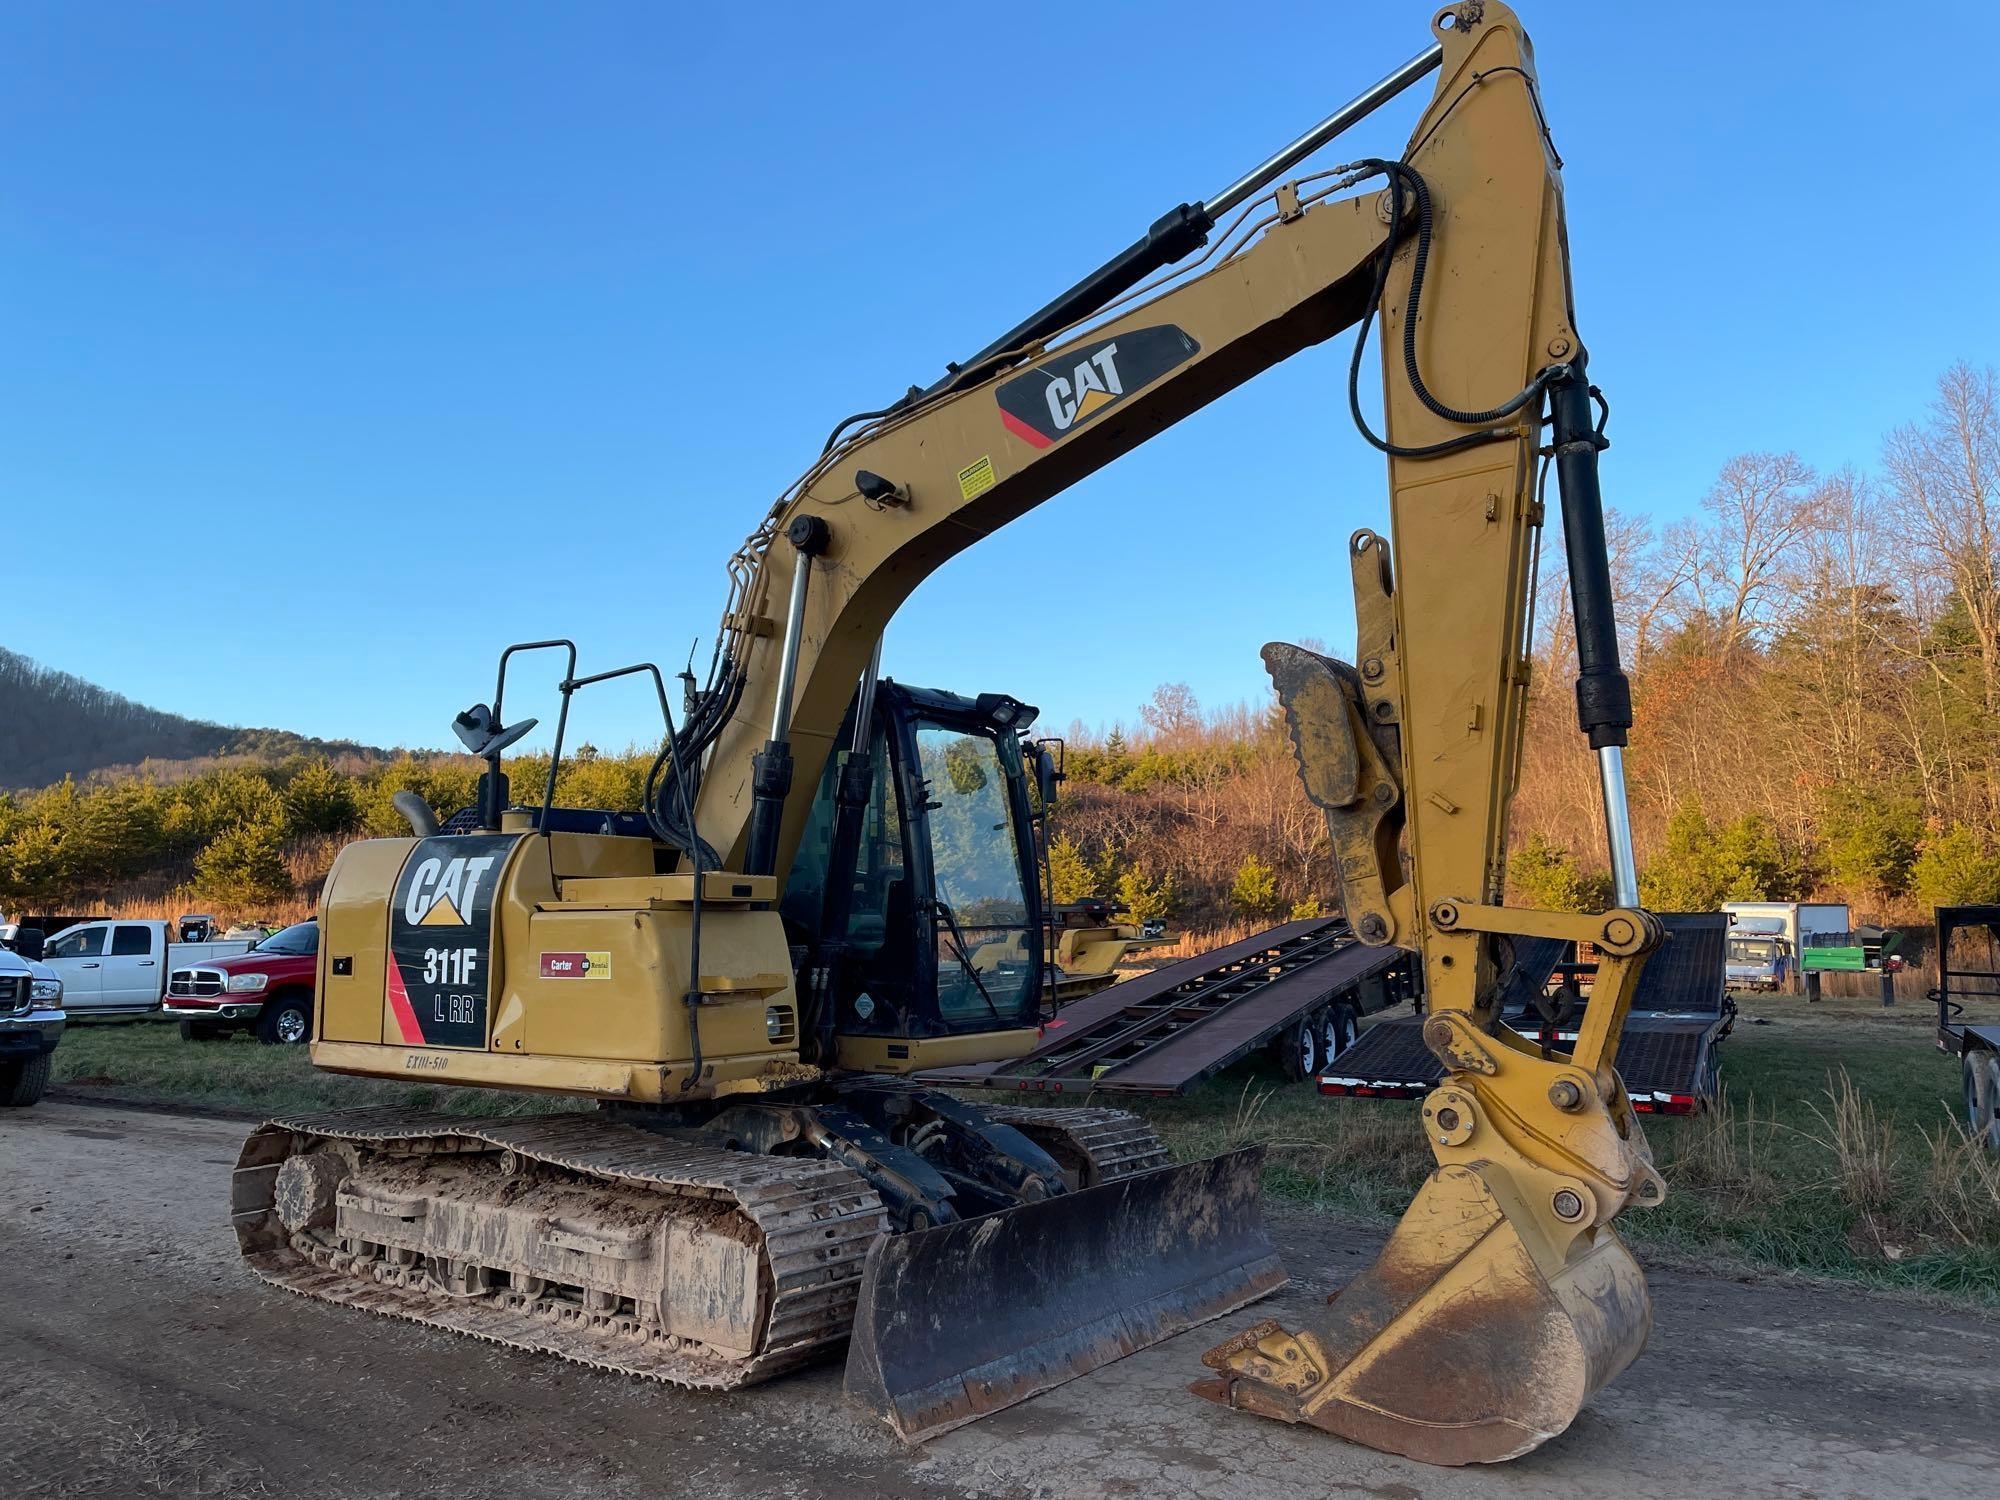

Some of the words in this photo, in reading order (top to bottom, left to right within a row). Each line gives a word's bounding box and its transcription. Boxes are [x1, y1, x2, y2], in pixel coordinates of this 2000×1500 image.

[1045, 343, 1123, 430] CAT
[405, 857, 495, 926] CAT
[423, 948, 477, 985] 311F
[551, 959, 573, 971] Carter
[434, 994, 445, 1022] L
[449, 994, 475, 1023] RR
